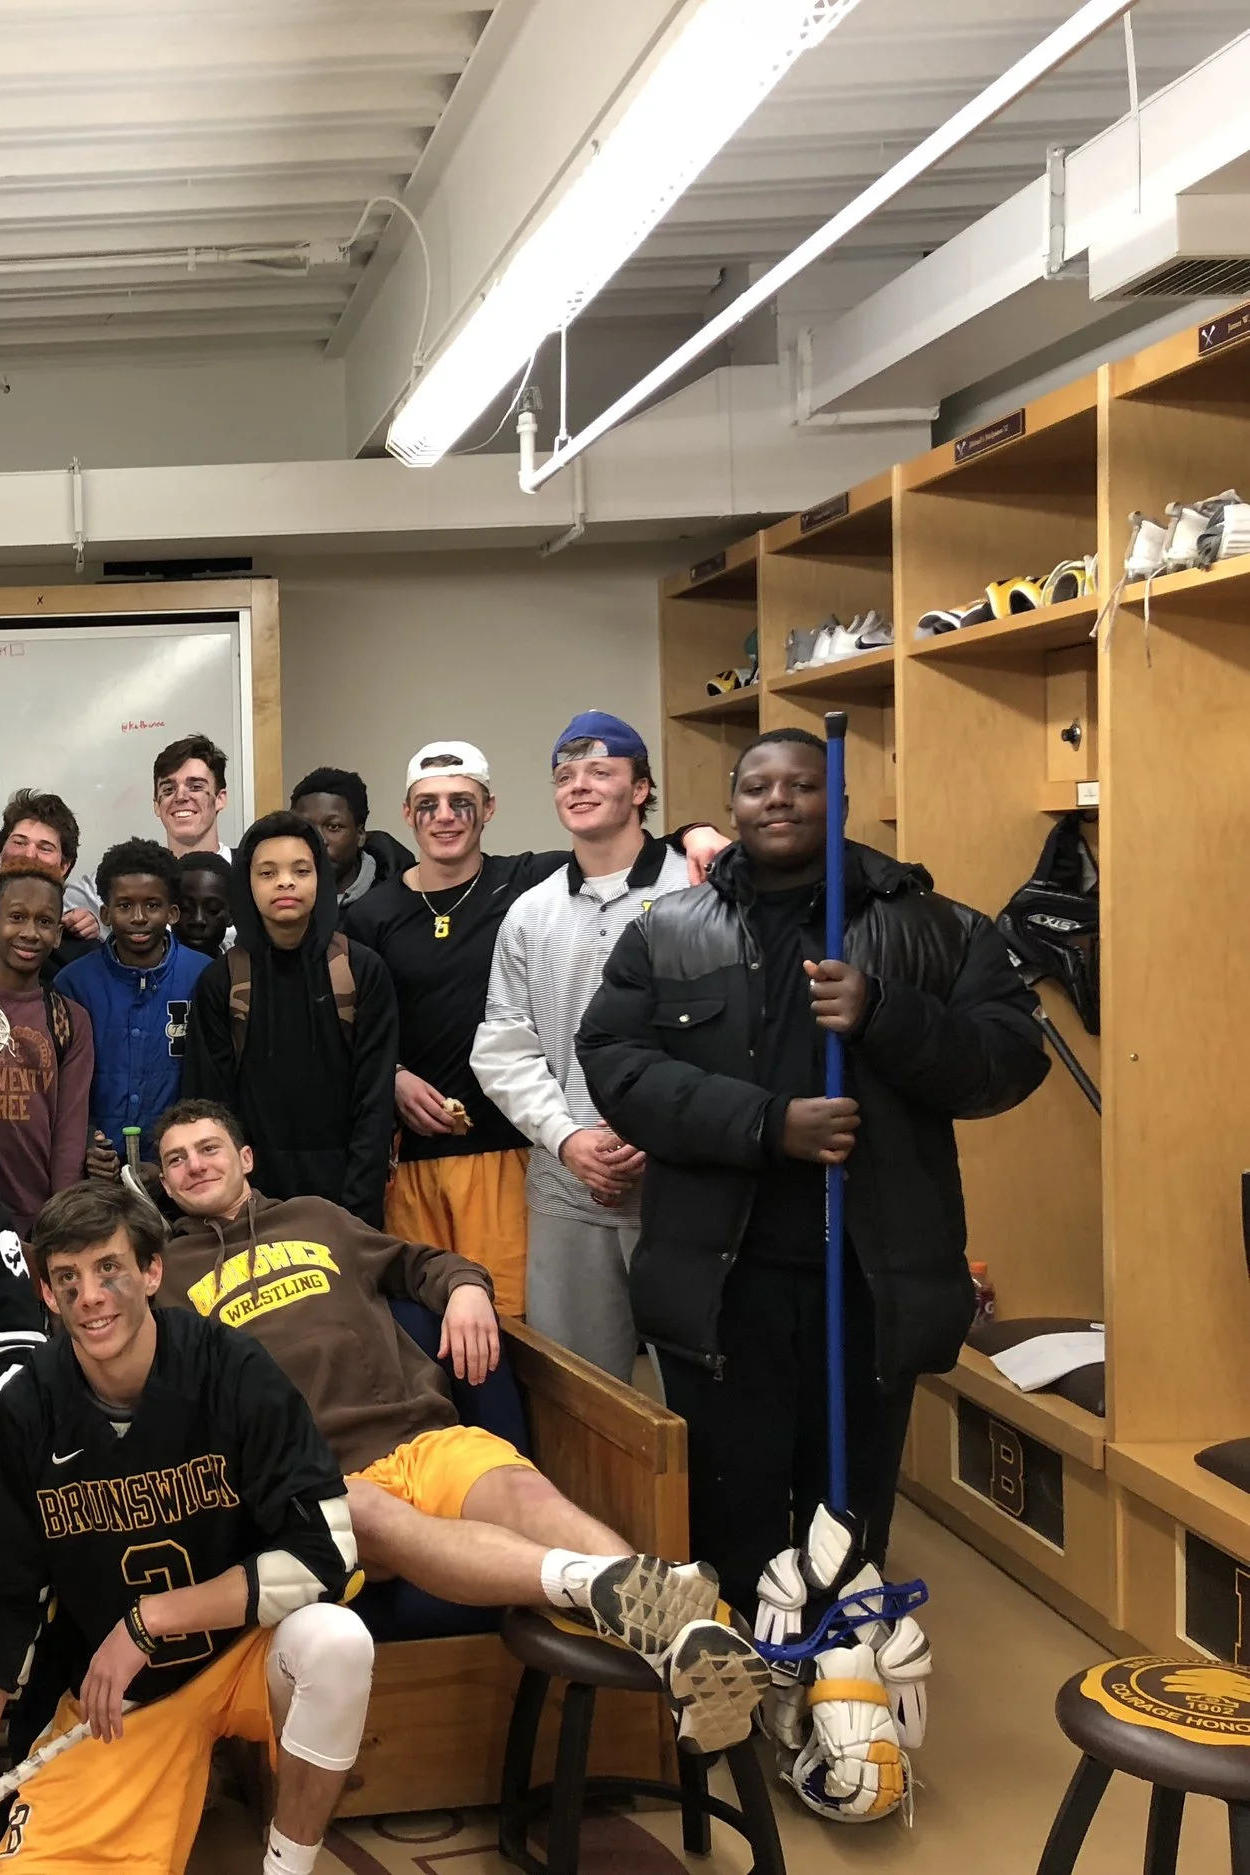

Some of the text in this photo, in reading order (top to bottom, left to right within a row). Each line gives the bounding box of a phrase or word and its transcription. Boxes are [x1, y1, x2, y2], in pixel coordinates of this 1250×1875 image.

[1043, 916, 1072, 931] STX
[988, 1419, 1025, 1517] B
[36, 1453, 240, 1540] BRUNSWICK
[1111, 1683, 1184, 1721] COURAGE
[1187, 1701, 1235, 1716] 1902
